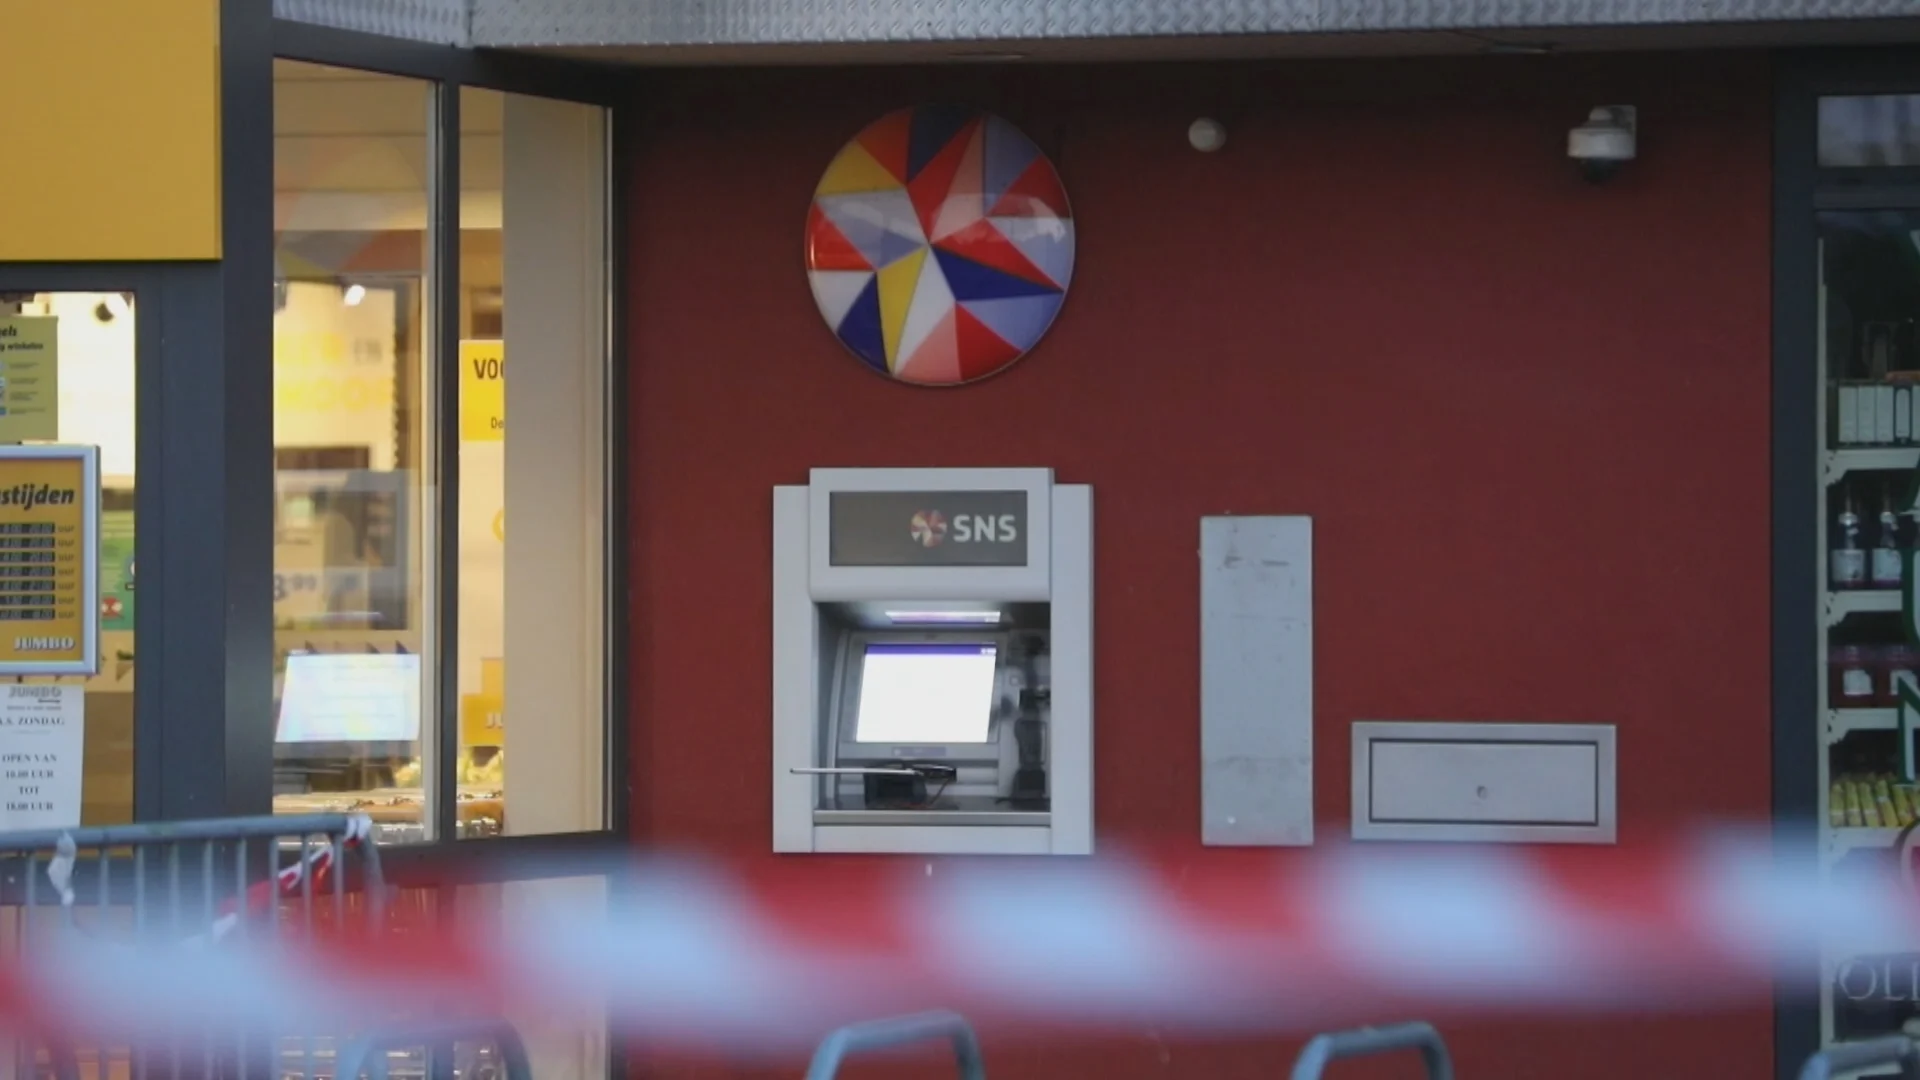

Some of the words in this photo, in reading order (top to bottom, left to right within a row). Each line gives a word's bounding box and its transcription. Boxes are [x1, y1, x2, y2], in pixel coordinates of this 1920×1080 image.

[0, 483, 75, 511] stijden
[953, 514, 1017, 542] SNS
[14, 636, 75, 651] JUMBO
[9, 686, 62, 698] JUMBO
[18, 717, 65, 726] ZONDAG
[2, 753, 31, 763] OPEN
[34, 753, 57, 763] VAN
[31, 769, 54, 779] UUR
[18, 785, 39, 796] TOT
[31, 801, 54, 811] UUR
